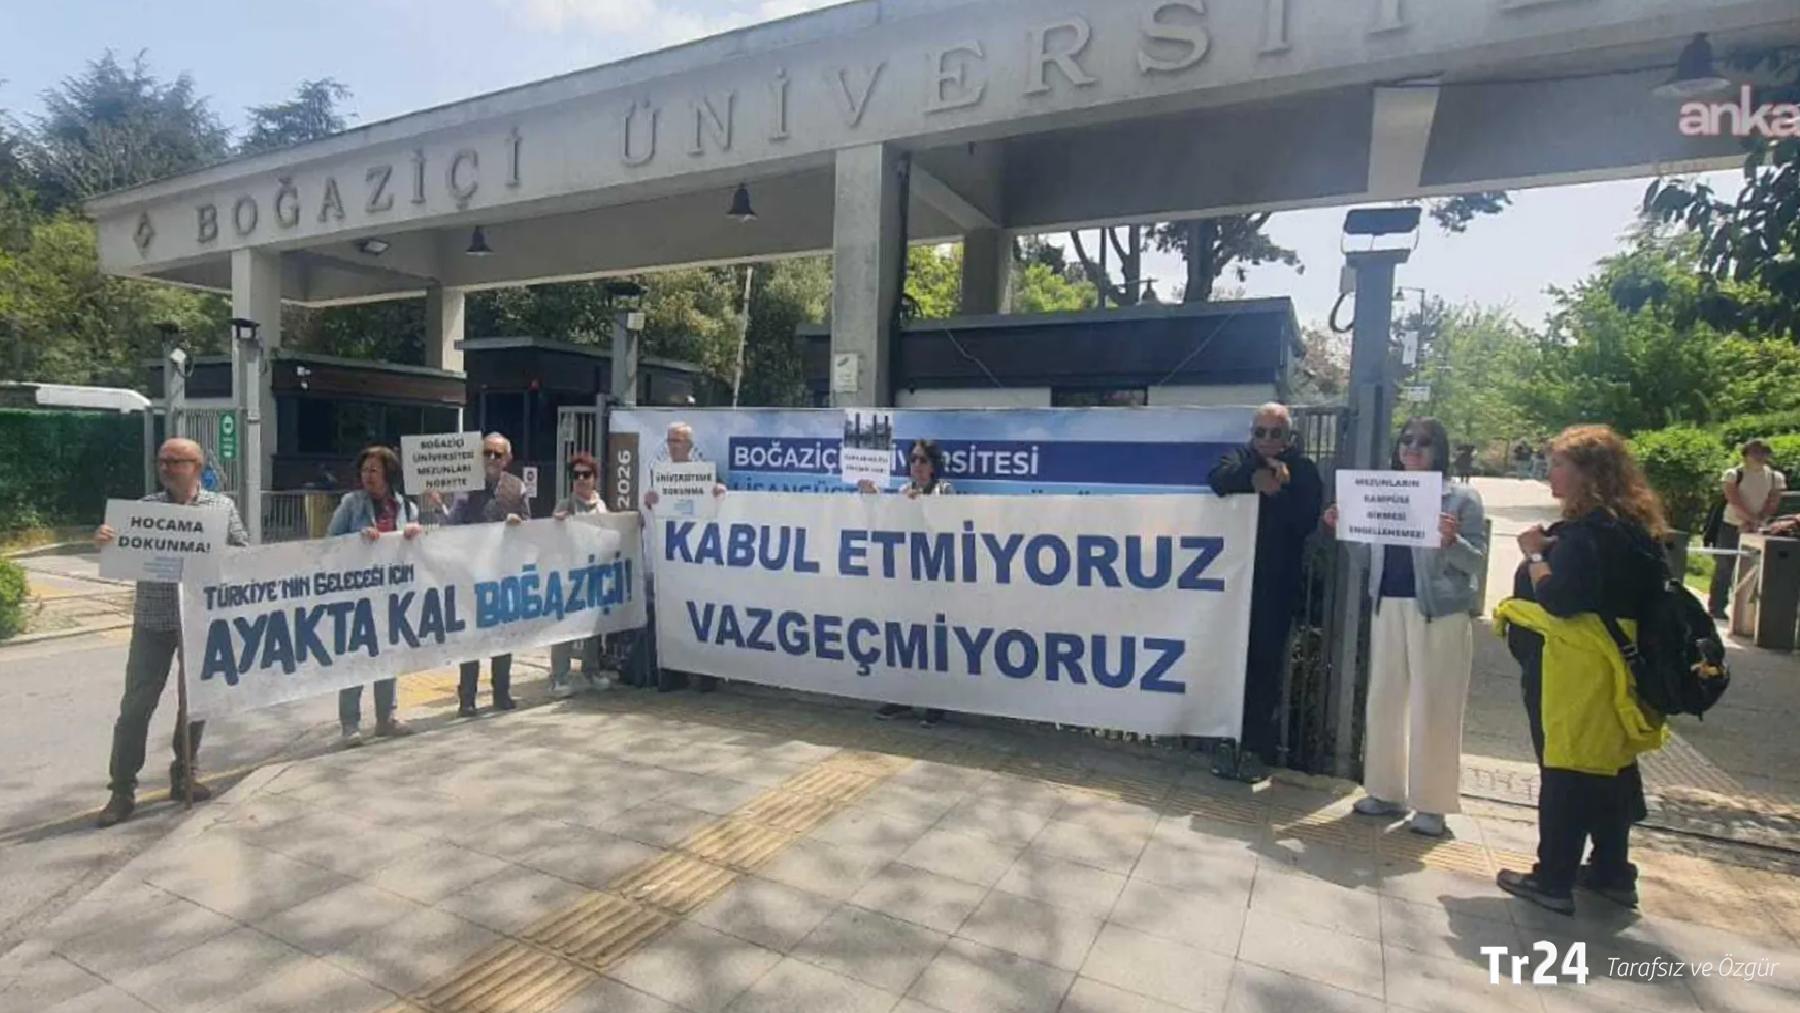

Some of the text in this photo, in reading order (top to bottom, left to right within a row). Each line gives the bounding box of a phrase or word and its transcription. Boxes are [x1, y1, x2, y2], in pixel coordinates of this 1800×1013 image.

[196, 125, 522, 244] BOĞAZİÇİ
[617, 450, 631, 508] 2026
[118, 535, 211, 553] DOKUNMA!
[131, 516, 204, 533] HOCAMA
[665, 520, 1225, 592] KABUL ETMİYORUZ
[200, 551, 632, 686] AYAKTA KAL BOĞAZİÇİ!
[203, 562, 415, 610] TÜRKİYE'NİN GELECEĞİ İÇİN
[686, 601, 1186, 694] VAZGEÇMİYORUZ
